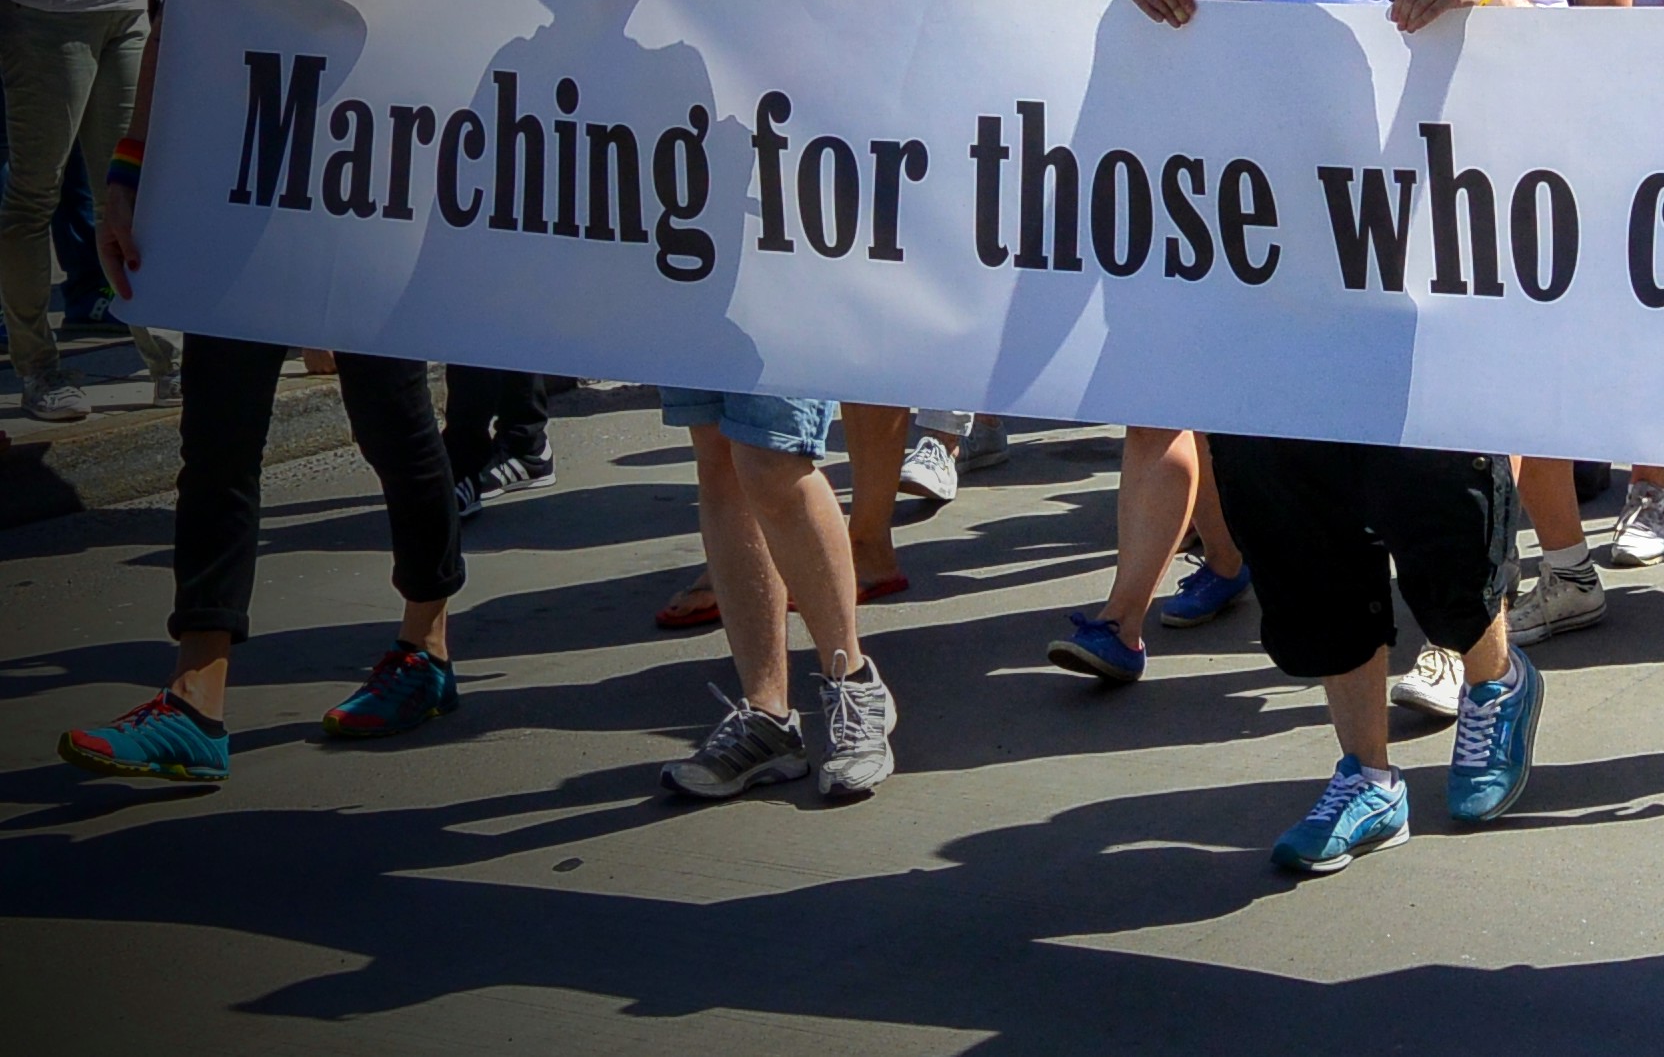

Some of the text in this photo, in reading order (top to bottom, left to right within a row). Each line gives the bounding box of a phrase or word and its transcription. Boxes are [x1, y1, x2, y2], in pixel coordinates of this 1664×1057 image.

[228, 49, 719, 283] Marching
[750, 90, 929, 263] for
[968, 100, 1281, 285] those
[1316, 122, 1580, 303] who
